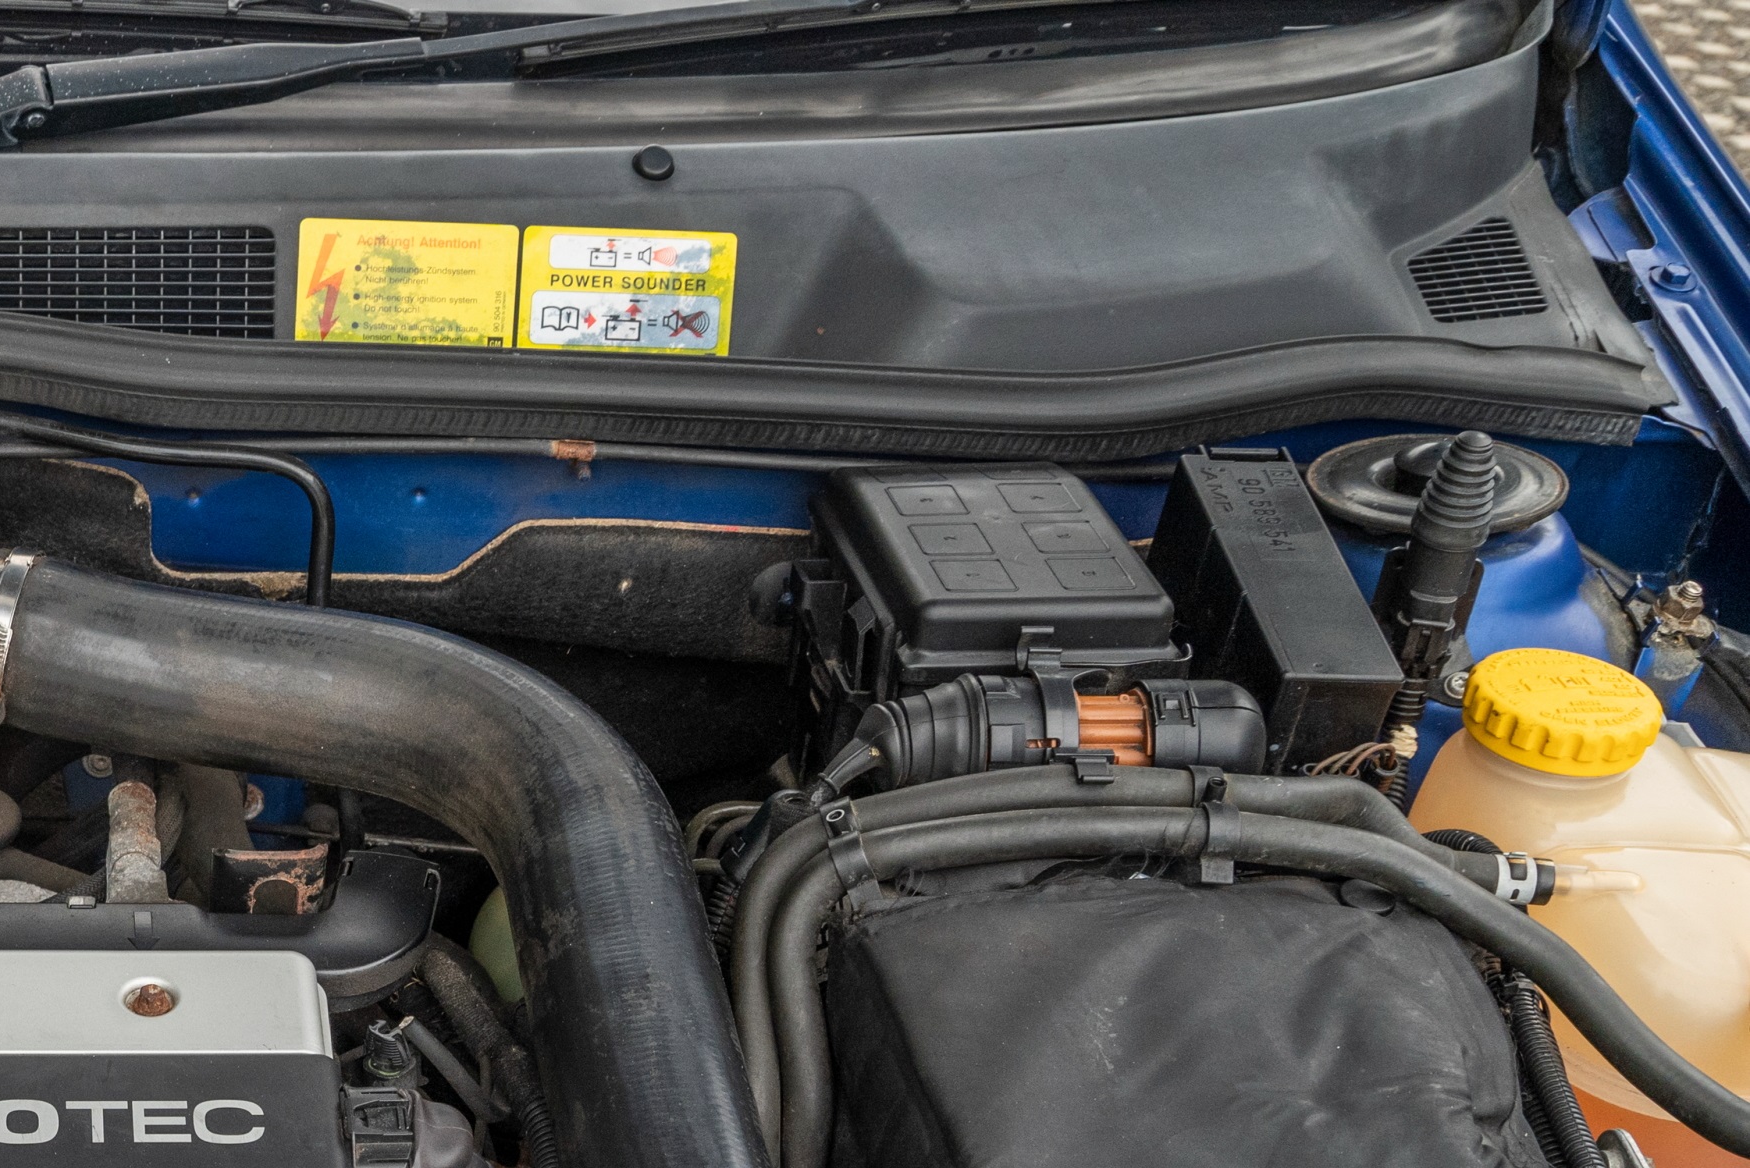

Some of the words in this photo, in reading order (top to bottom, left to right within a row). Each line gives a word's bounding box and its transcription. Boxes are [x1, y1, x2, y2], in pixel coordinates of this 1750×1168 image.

[357, 234, 414, 250] Achtung!
[420, 236, 481, 249] Attention!
[366, 276, 386, 284] Nicht
[550, 274, 613, 289] POWER
[621, 277, 707, 291] SOUNDER
[365, 293, 414, 304] High-energy
[417, 295, 446, 304] ignition
[364, 305, 376, 313] Do
[394, 305, 420, 313] touch!
[493, 322, 500, 332] 90
[1200, 469, 1233, 512] AMP
[1238, 479, 1265, 494] 90
[1249, 500, 1281, 525] 589
[1264, 530, 1296, 552] 541
